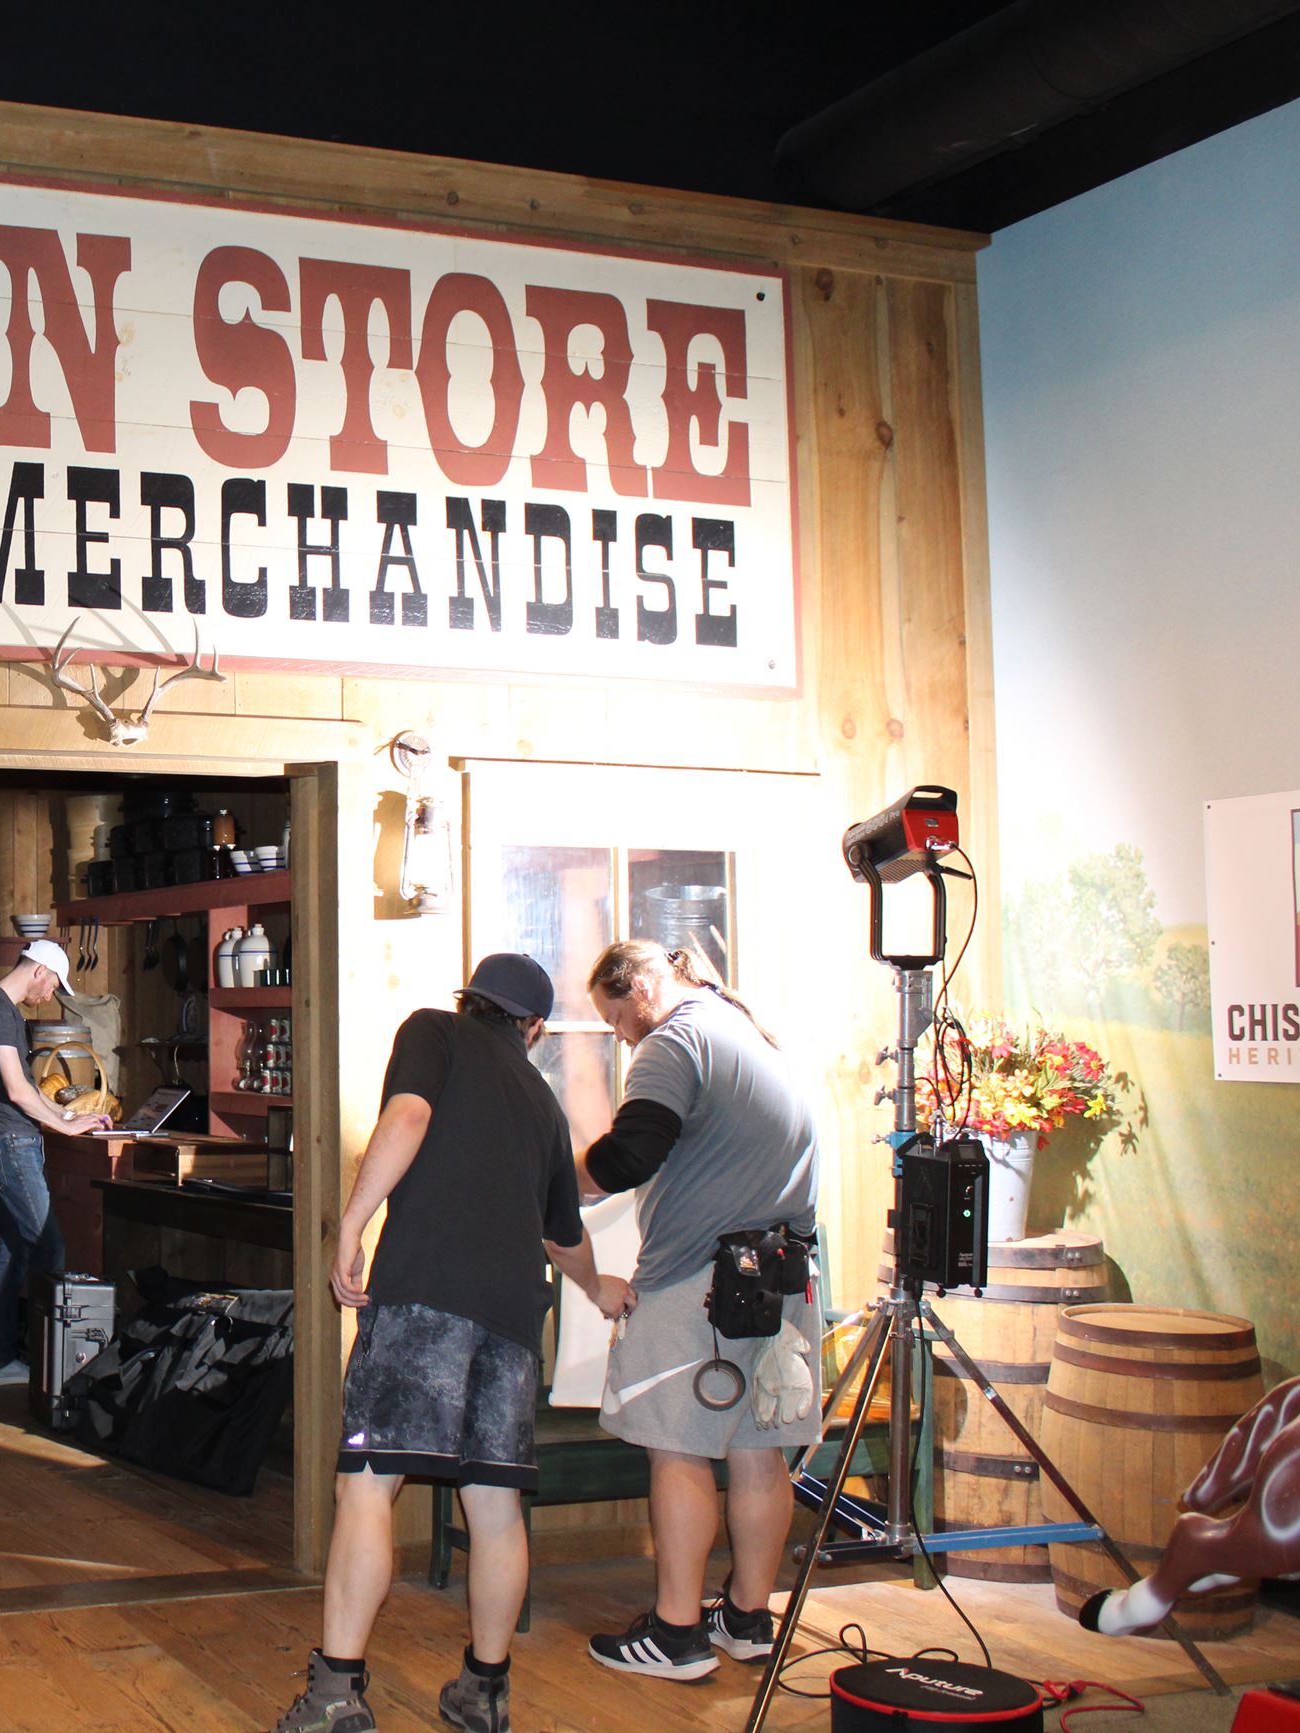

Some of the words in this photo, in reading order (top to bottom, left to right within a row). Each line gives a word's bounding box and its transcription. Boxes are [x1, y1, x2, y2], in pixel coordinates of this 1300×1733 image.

[189, 245, 753, 507] STORE
[1228, 1047, 1300, 1064] HERI
[885, 1667, 984, 1696] Aputure
